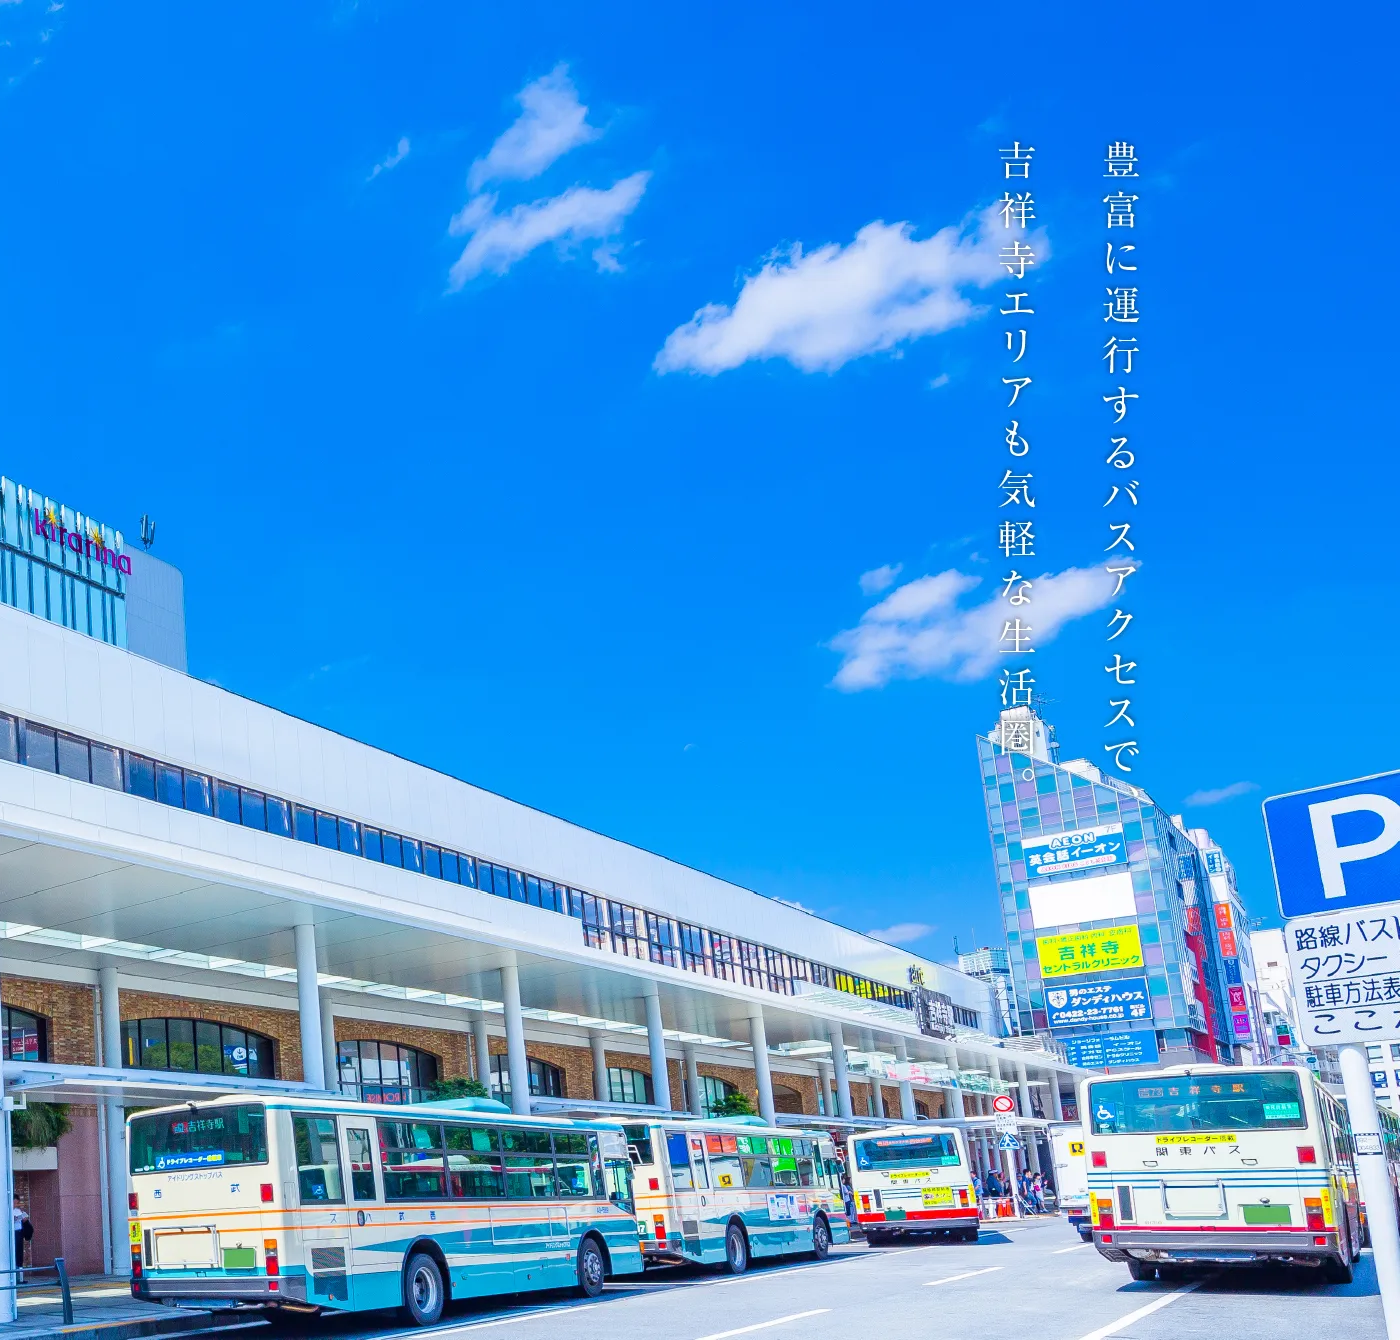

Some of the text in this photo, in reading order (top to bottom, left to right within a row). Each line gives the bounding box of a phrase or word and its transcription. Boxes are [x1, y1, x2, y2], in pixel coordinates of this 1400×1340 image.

[1050, 831, 1097, 849] AEON
[1308, 793, 1400, 899] P
[1028, 842, 1121, 866] 英会話イーオン
[1057, 940, 1119, 960] 吉祥寺
[1043, 955, 1140, 973] セントラルクリニック
[1300, 953, 1388, 979] タクシー
[1069, 985, 1112, 997] 男のエステ
[1071, 991, 1145, 1007] ダンディハウス
[1305, 976, 1400, 1008] 駐車方法表
[1131, 1008, 1146, 1017] 4F
[1168, 1083, 1245, 1096] 吉祥寺駅
[188, 1117, 225, 1133] 吉祥寺駅
[1155, 1145, 1242, 1157] 関東バス
[167, 1171, 223, 1182] アイドリングストップバス
